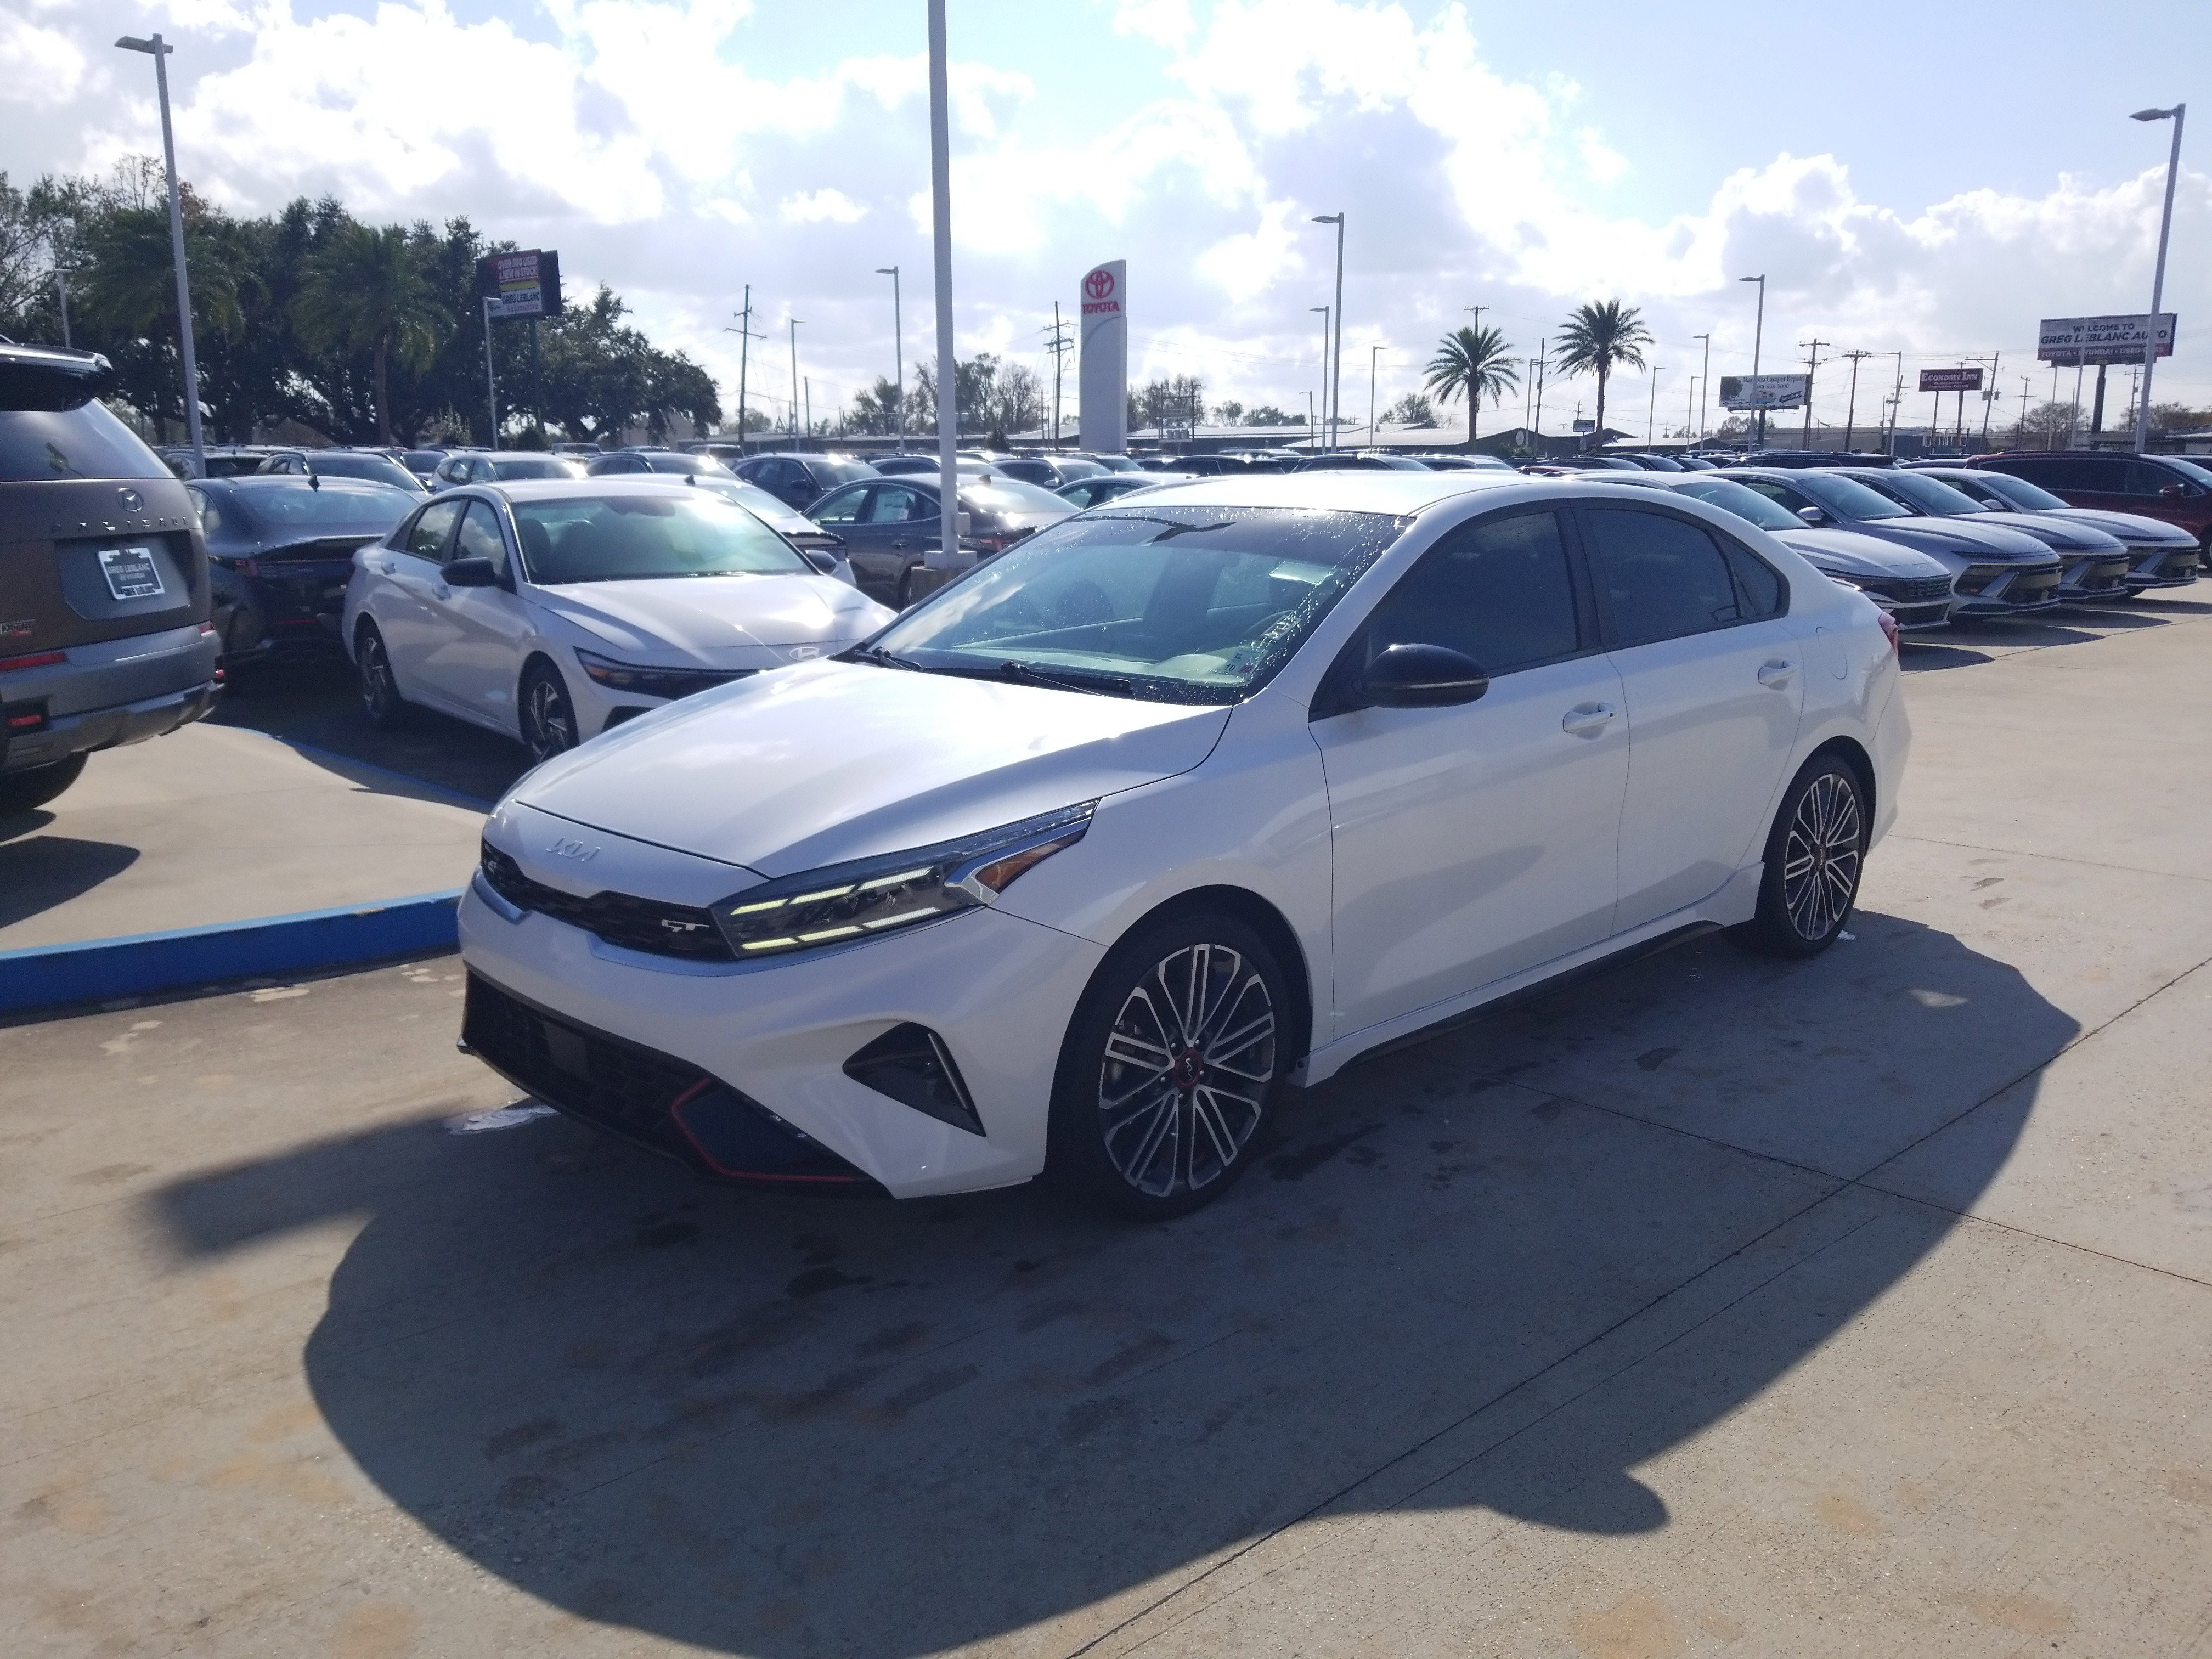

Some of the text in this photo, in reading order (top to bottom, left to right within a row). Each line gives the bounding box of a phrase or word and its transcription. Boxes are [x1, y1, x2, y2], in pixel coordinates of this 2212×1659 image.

[502, 291, 540, 304] GREG LEBLANC
[1081, 301, 1120, 314] TOYOTA
[2073, 323, 2119, 332] WLCOME
[2041, 334, 2072, 344] GREG
[2131, 330, 2168, 340] AUO
[1767, 375, 1786, 383] Camper
[546, 837, 601, 862] KIA
[661, 919, 710, 933] GT
